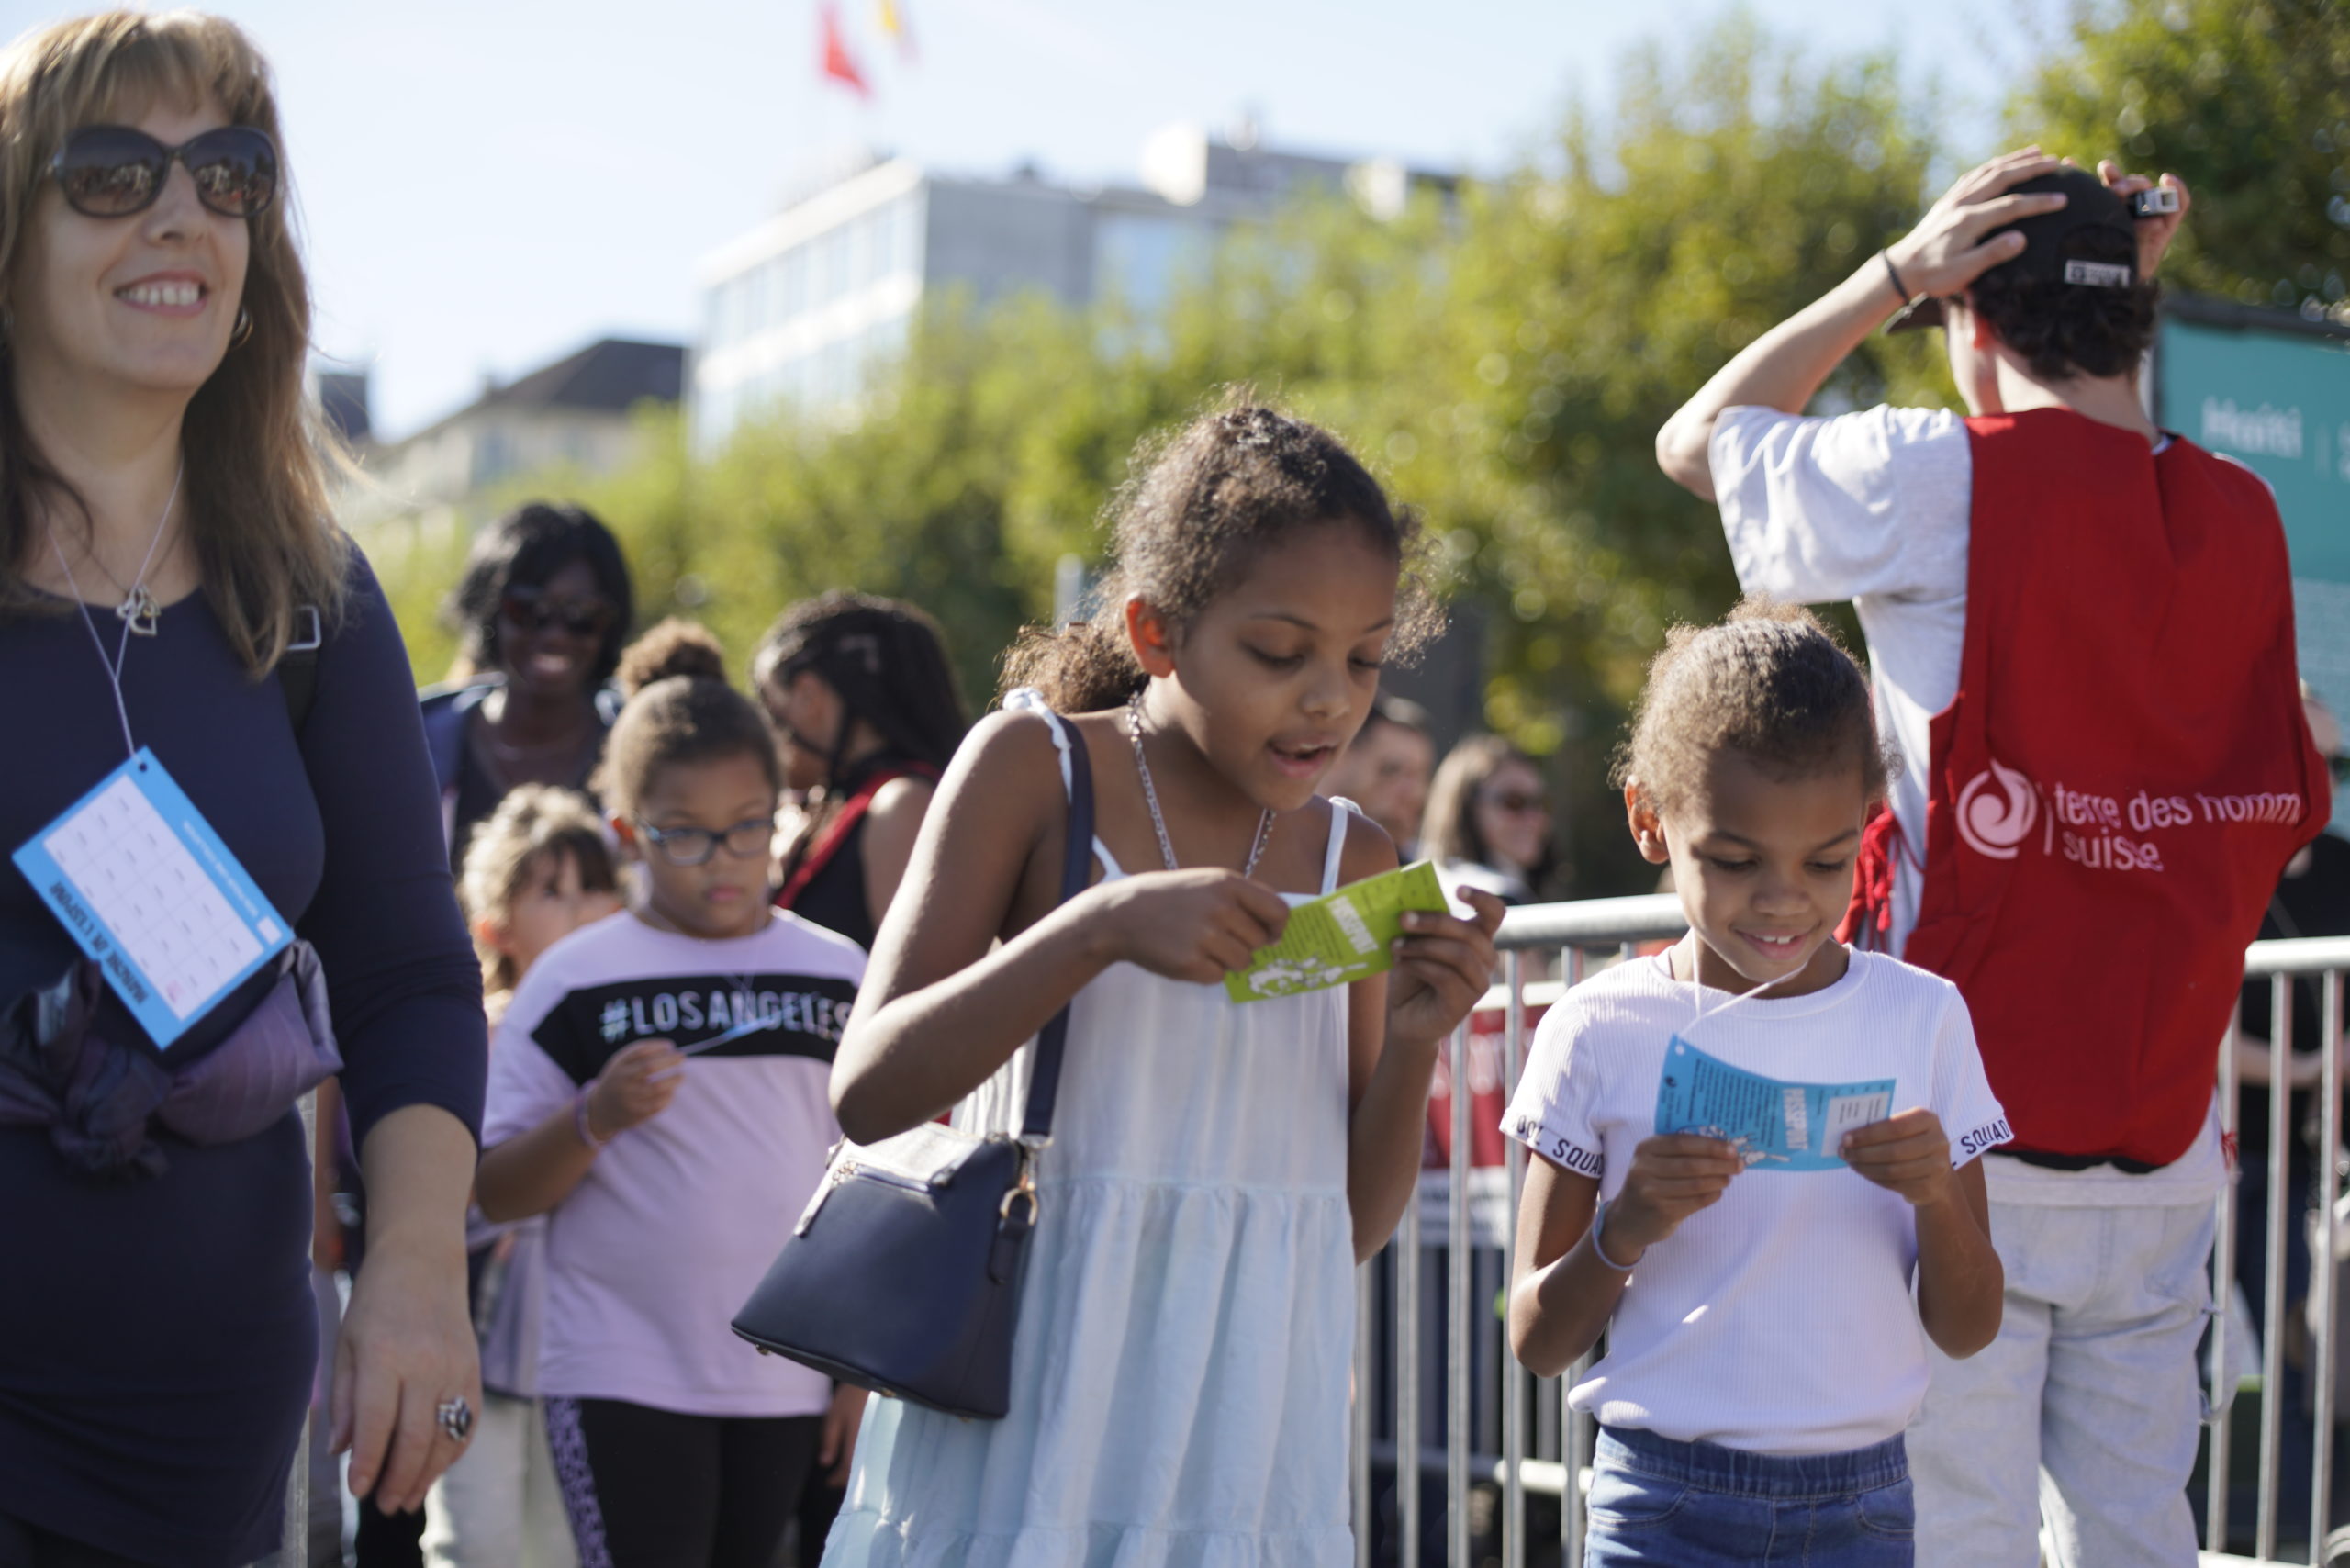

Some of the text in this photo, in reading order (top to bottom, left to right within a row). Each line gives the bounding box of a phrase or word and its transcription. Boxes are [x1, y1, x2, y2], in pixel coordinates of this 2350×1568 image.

[2055, 781, 2121, 828] terre
[2128, 790, 2193, 832] des
[2063, 826, 2164, 871] suisse
[1960, 1119, 2010, 1154] SQUAD
